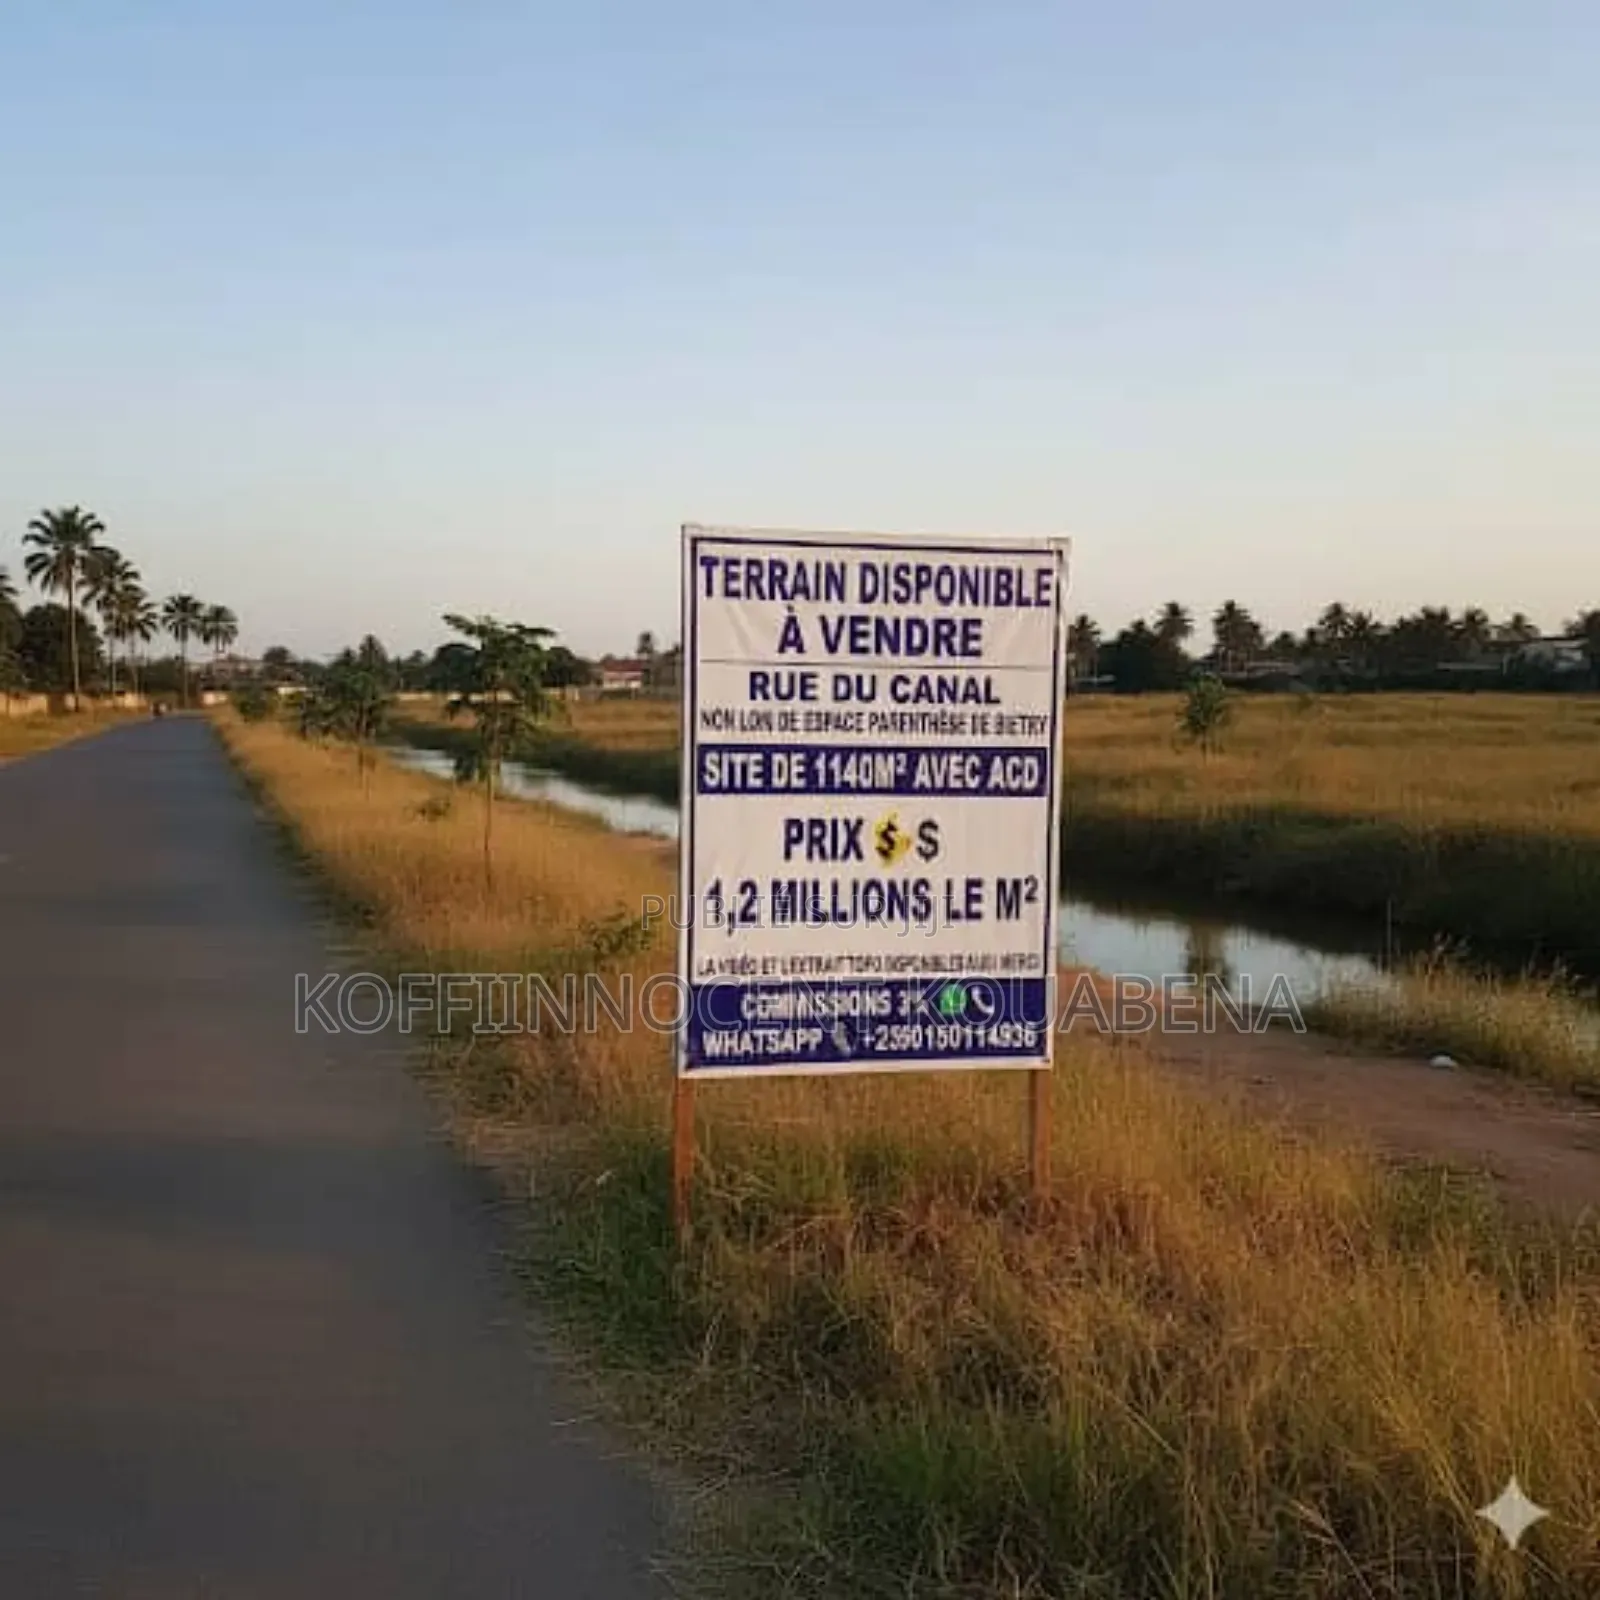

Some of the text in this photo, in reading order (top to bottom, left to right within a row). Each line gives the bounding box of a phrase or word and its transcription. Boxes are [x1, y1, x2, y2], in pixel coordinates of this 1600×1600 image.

[700, 556, 1054, 608] TERRAIN DISPONIBLE
[777, 605, 984, 657] À VENDRE
[749, 671, 1002, 705] RUE DU CANAL
[703, 752, 764, 788] SITE
[771, 752, 806, 788] DE
[912, 753, 982, 790] AVEC
[987, 755, 1040, 790] ACD
[783, 818, 865, 861] PRIX
[704, 874, 1039, 936] 1,2 MILLIONS LE M²
[702, 1026, 823, 1058] WHATSAPP
